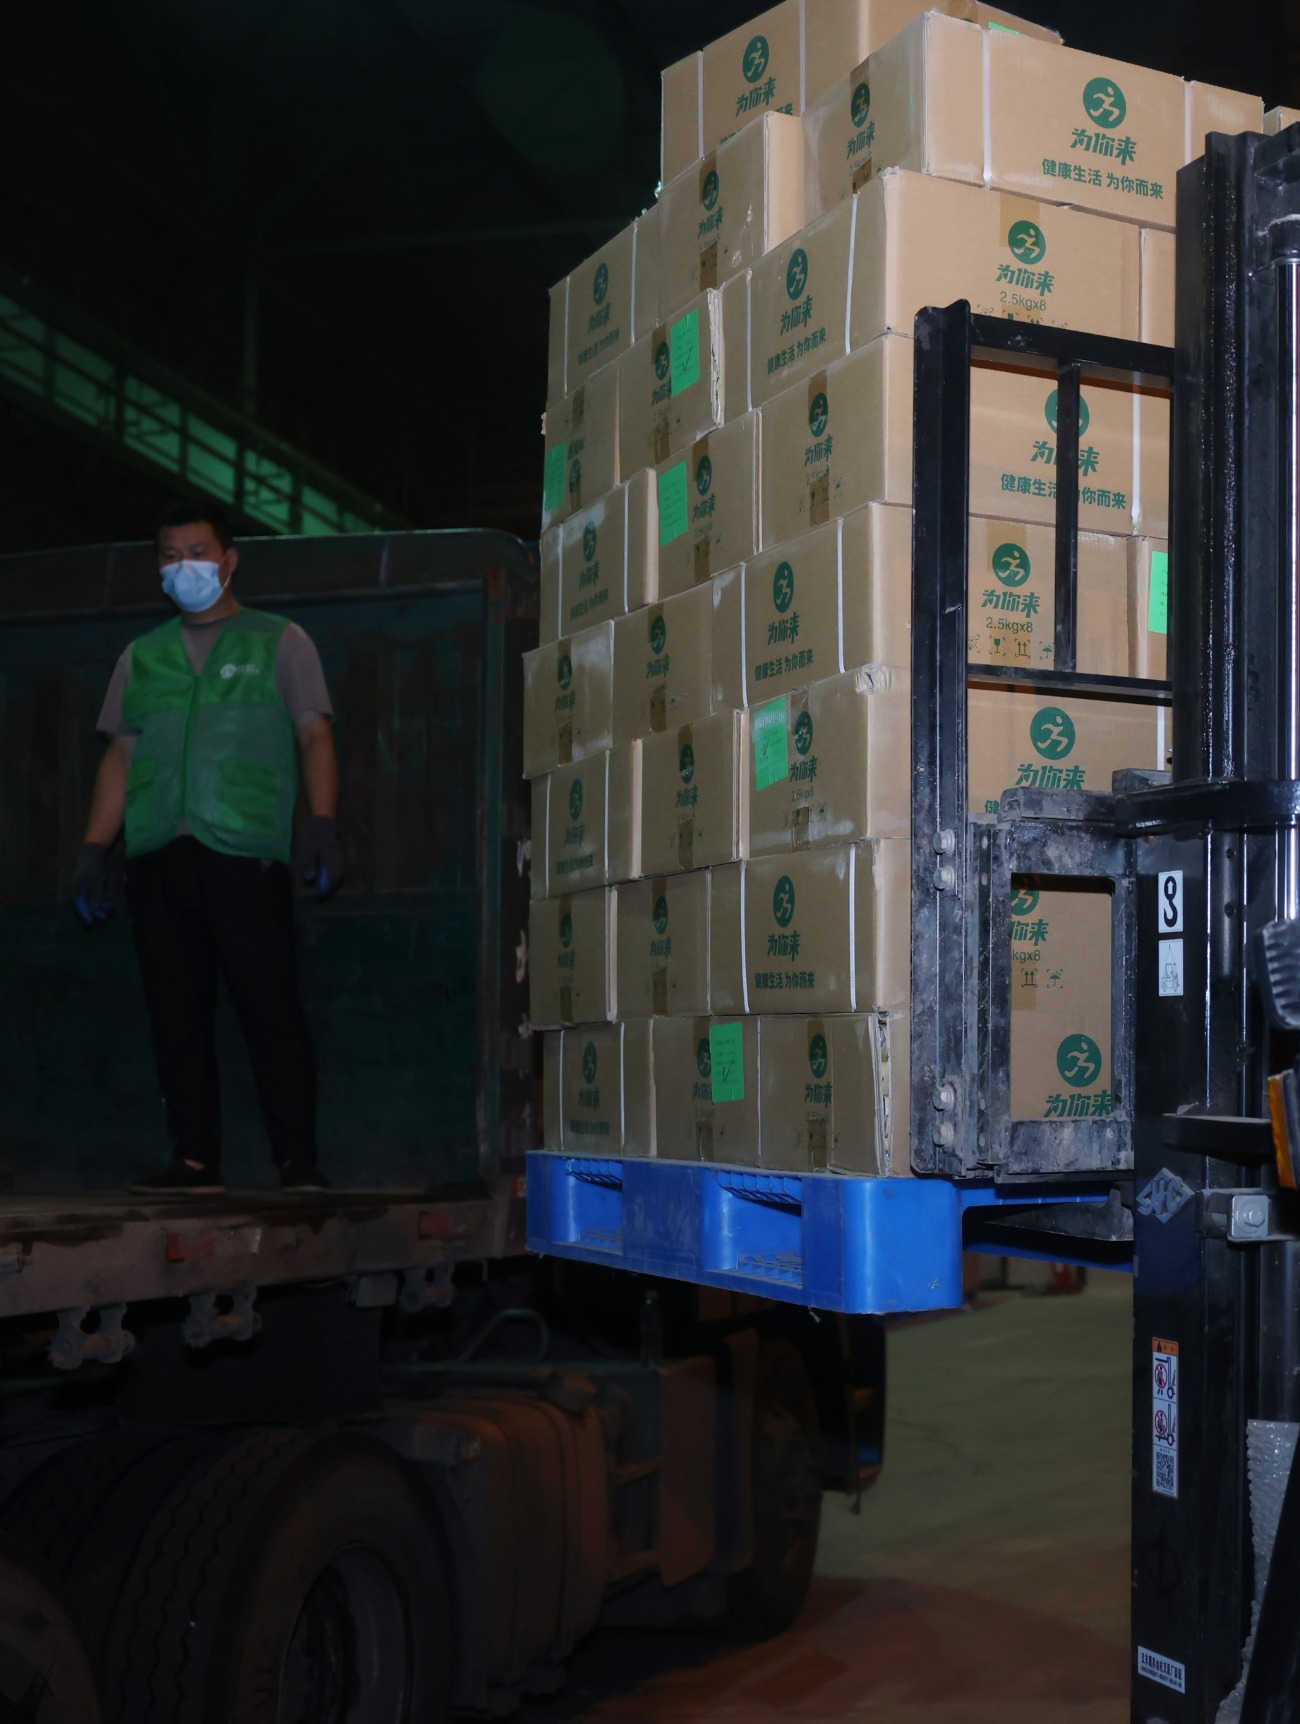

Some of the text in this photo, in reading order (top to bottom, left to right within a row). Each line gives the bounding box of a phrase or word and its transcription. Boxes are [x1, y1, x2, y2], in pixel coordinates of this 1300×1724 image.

[735, 76, 777, 117] 为你来
[1069, 128, 1138, 166] 为你来
[1041, 157, 1165, 201] 健康生活 为你而来
[995, 263, 1055, 297] 为你来
[780, 295, 813, 336] 为你来
[1000, 290, 1047, 312] 2.5kgx8
[1030, 440, 1100, 477] 为来
[1078, 487, 1127, 510] 你而来
[981, 589, 1040, 619] 为你来
[768, 611, 800, 646] 为你来
[985, 617, 1034, 635] 2.5kgx8
[789, 755, 818, 784] 为你来
[1014, 763, 1087, 790] 为你来
[767, 930, 801, 962] 为你来
[1011, 919, 1050, 947] 你来
[1011, 949, 1041, 964] kgx8
[1044, 1090, 1112, 1118] 为你来
